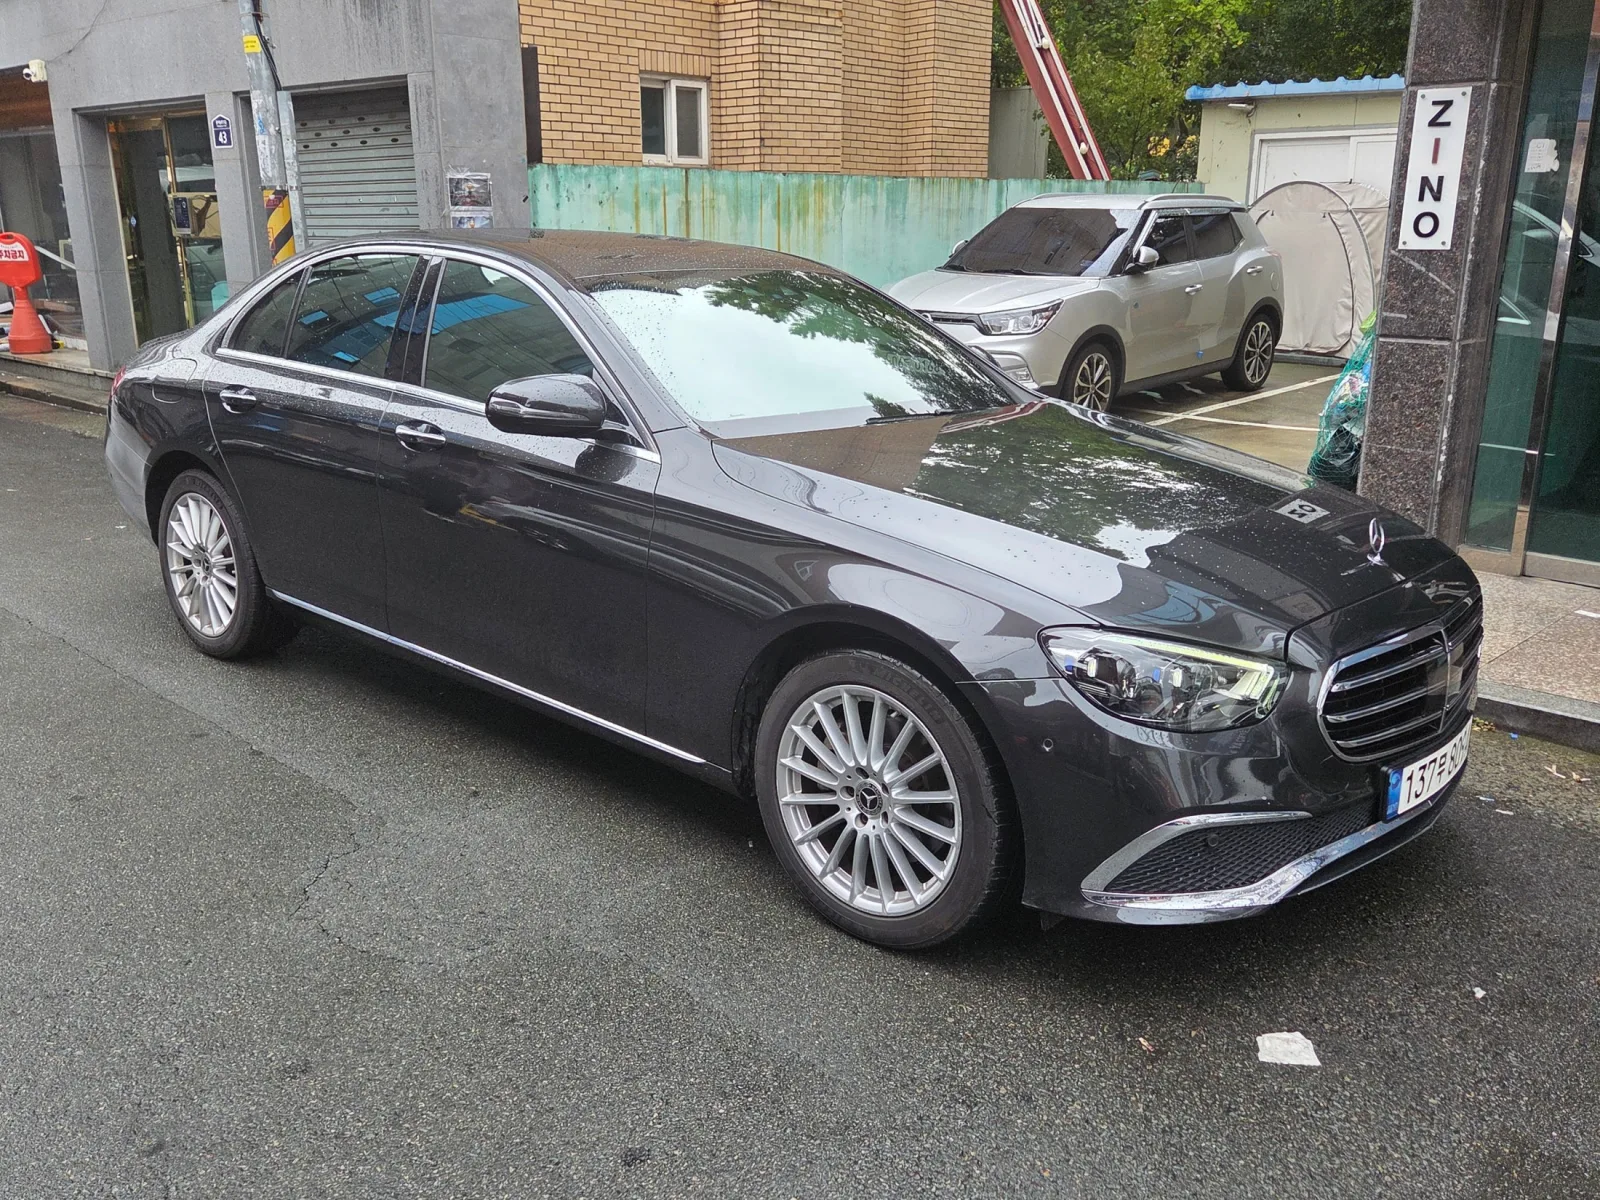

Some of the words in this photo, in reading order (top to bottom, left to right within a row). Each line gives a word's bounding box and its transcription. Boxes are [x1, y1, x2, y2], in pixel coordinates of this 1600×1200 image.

[218, 130, 228, 145] 43
[1412, 99, 1454, 239] ZINO
[1406, 752, 1448, 804] 137무
